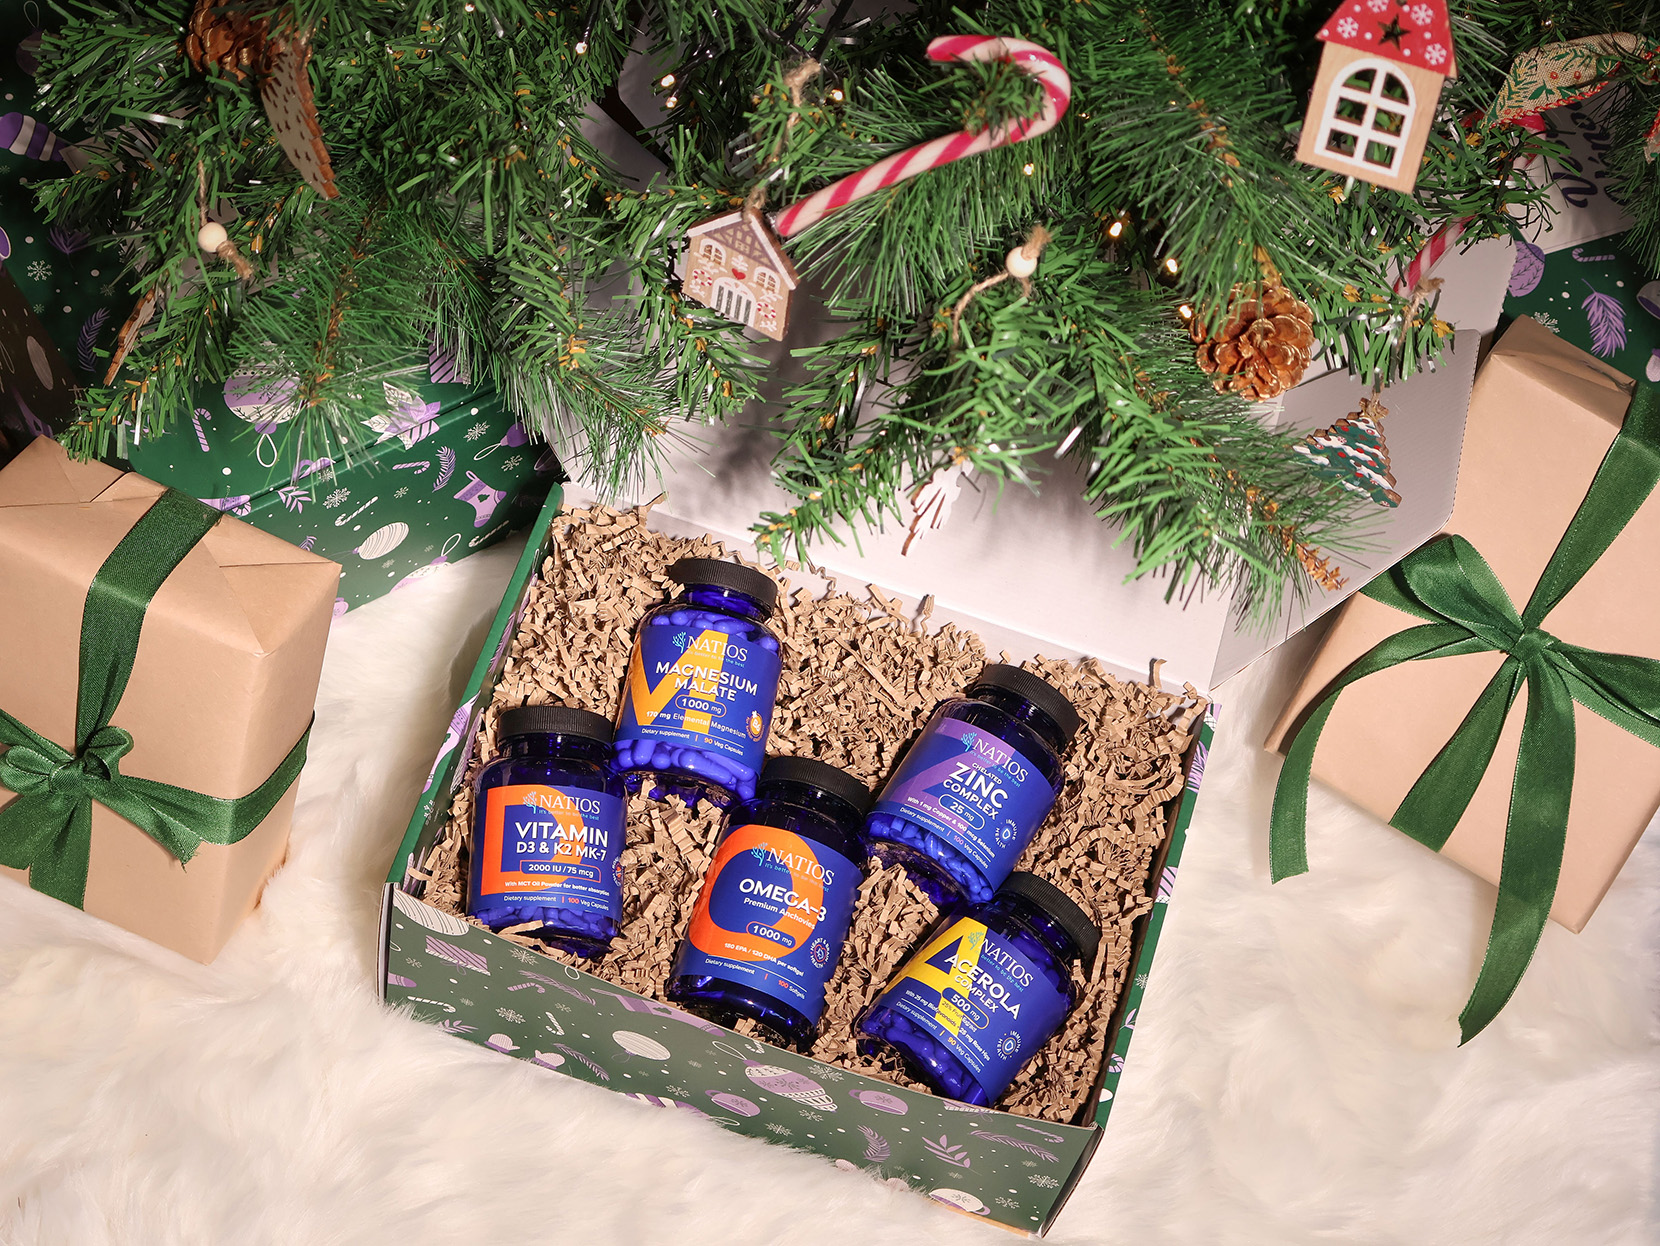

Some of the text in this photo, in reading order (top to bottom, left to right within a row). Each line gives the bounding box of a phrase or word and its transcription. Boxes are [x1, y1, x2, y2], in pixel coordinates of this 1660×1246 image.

[686, 635, 748, 662] NATIOS
[656, 661, 758, 696] MAGNESIUM
[674, 677, 737, 702] MALATE
[681, 698, 722, 714] 1000 mg
[646, 710, 658, 718] 170
[659, 712, 671, 720] mg
[672, 712, 710, 726] Elemental
[711, 720, 747, 739] Magnesium
[641, 728, 659, 736] Dietary
[659, 729, 690, 740] supplement
[714, 740, 724, 750] Veg
[724, 744, 744, 756] Capsules
[971, 762, 1003, 785] CHELATED
[972, 738, 1029, 782] NATIOS
[943, 778, 999, 820] COMPLEX
[948, 761, 1009, 809] ZINC
[539, 794, 601, 815] NATIOS
[949, 801, 975, 822] 25 mg
[515, 821, 609, 848] VITAMIN
[899, 806, 989, 869] Dietary supplement 100 Veg Capsules
[907, 796, 920, 806] With
[923, 802, 932, 811] mg
[932, 806, 953, 821] Copper
[956, 821, 968, 833] 100
[966, 829, 978, 842] mcg
[977, 837, 996, 859] Selenium
[994, 827, 1007, 849] HEALTH
[1005, 819, 1018, 841] IMMUNE
[516, 841, 607, 861] D3 & K2 MK-7
[528, 863, 551, 872] 2000
[552, 864, 562, 873] IU
[567, 866, 578, 875] 75
[578, 868, 594, 879] mcg
[764, 862, 773, 870] It's
[766, 847, 835, 886] NATIOS
[580, 899, 591, 908] Veg
[590, 901, 610, 911] Capsules
[739, 878, 827, 922] OMEGA-3
[743, 897, 816, 930] Premium Anchovies
[752, 925, 793, 946] 1000 mg
[735, 943, 748, 953] EPA
[752, 949, 763, 957] 120
[763, 953, 777, 963] DHA
[776, 959, 787, 968] per
[786, 964, 805, 977] softgel
[979, 937, 1034, 987] NATIOS
[705, 958, 806, 1000] Dietary supplement 100 Softgels
[944, 953, 1021, 1021] ACEROLA
[941, 1000, 953, 1012] 25%
[950, 993, 981, 1022] 500 mg
[954, 974, 1000, 1013] COMPLEX
[895, 1001, 982, 1073] Dietary supplement 90 Veg Capsules
[905, 989, 915, 999] With
[914, 993, 922, 1001] 25
[920, 998, 929, 1007] mg
[958, 1026, 968, 1036] 25
[965, 1033, 974, 1044] mg
[972, 1039, 983, 1052] Rose
[981, 1050, 991, 1062] Hips
[996, 1038, 1008, 1061] HEALTH
[1009, 1030, 1022, 1054] IMMUNE
